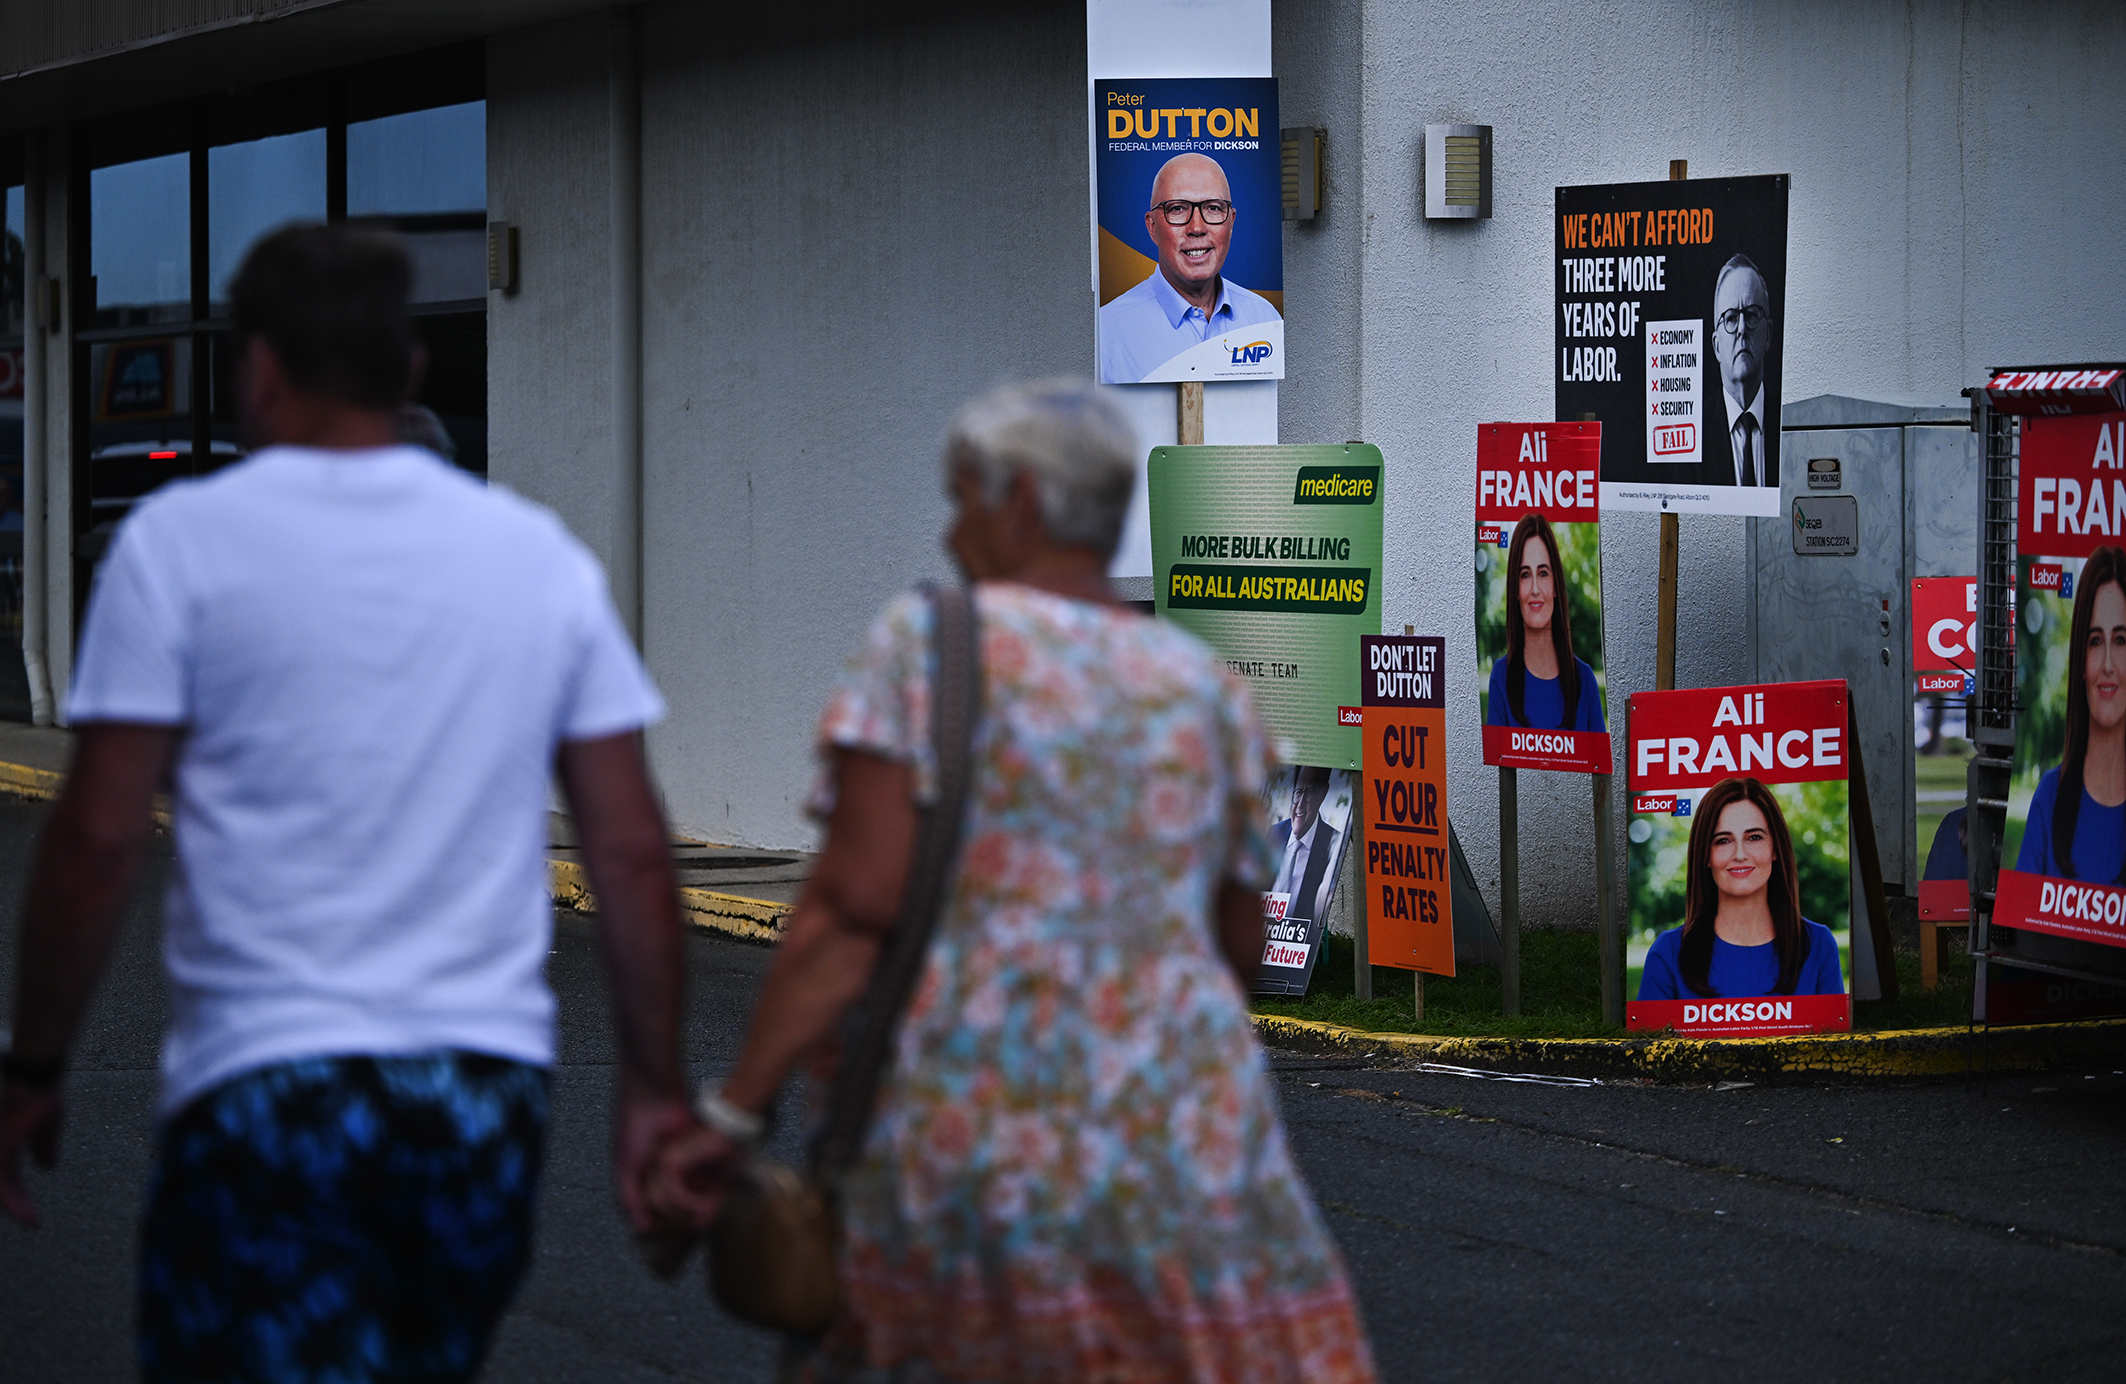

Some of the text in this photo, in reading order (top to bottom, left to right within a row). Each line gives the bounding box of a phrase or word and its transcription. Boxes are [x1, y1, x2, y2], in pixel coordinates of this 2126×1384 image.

[1107, 92, 1145, 106] Peter
[1107, 108, 1259, 139] DUTTON
[1108, 141, 1259, 152] FEDERAL MEMBER FOR DICKSON
[1563, 208, 1714, 249] WE CAN'T AFFORD
[1562, 255, 1666, 293] THREE MORE
[1562, 301, 1641, 338] YEARS OF
[1660, 329, 1694, 345] ECONOMY
[1231, 346, 1270, 364] LNP
[1562, 346, 1622, 382] LABOR.
[1659, 353, 1697, 369] INFLATION
[1660, 377, 1691, 393] HOUSING
[1660, 401, 1694, 416] SECURITY
[1518, 431, 1548, 462] Ali
[1662, 430, 1689, 449] FAIL
[2092, 421, 2124, 470] Al
[1299, 473, 1373, 497] medicare
[1479, 469, 1595, 508] FRANCE
[1808, 474, 1840, 482] HIGH VOLTAGE
[1479, 529, 1499, 541] Labor
[1806, 536, 1850, 547] STATION SC2274
[1181, 535, 1350, 561] MORE BULK BILLING
[1171, 574, 1365, 603] FOR ALL AUSTRALIANS
[2031, 567, 2059, 587] Labor
[1226, 660, 1264, 677] SENATE
[1271, 662, 1298, 678] TEAM
[1370, 644, 1437, 672] DON'T LET
[1377, 672, 1432, 700] DUTTON
[1922, 677, 1960, 690] Labor
[1340, 709, 1362, 724] Labor
[1712, 692, 1764, 727] Ali
[1382, 724, 1428, 770] CUT
[1511, 732, 1575, 754] DICKSON
[1636, 727, 1842, 777] FRANCE
[1374, 778, 1438, 827] YOUR
[1636, 797, 1673, 811] Labor
[1368, 840, 1446, 882] PENALTY
[1382, 884, 1439, 925] RATES
[2039, 881, 2126, 926] DICKSO
[1264, 944, 1306, 966] Future
[1683, 1002, 1792, 1024] DICKSON
